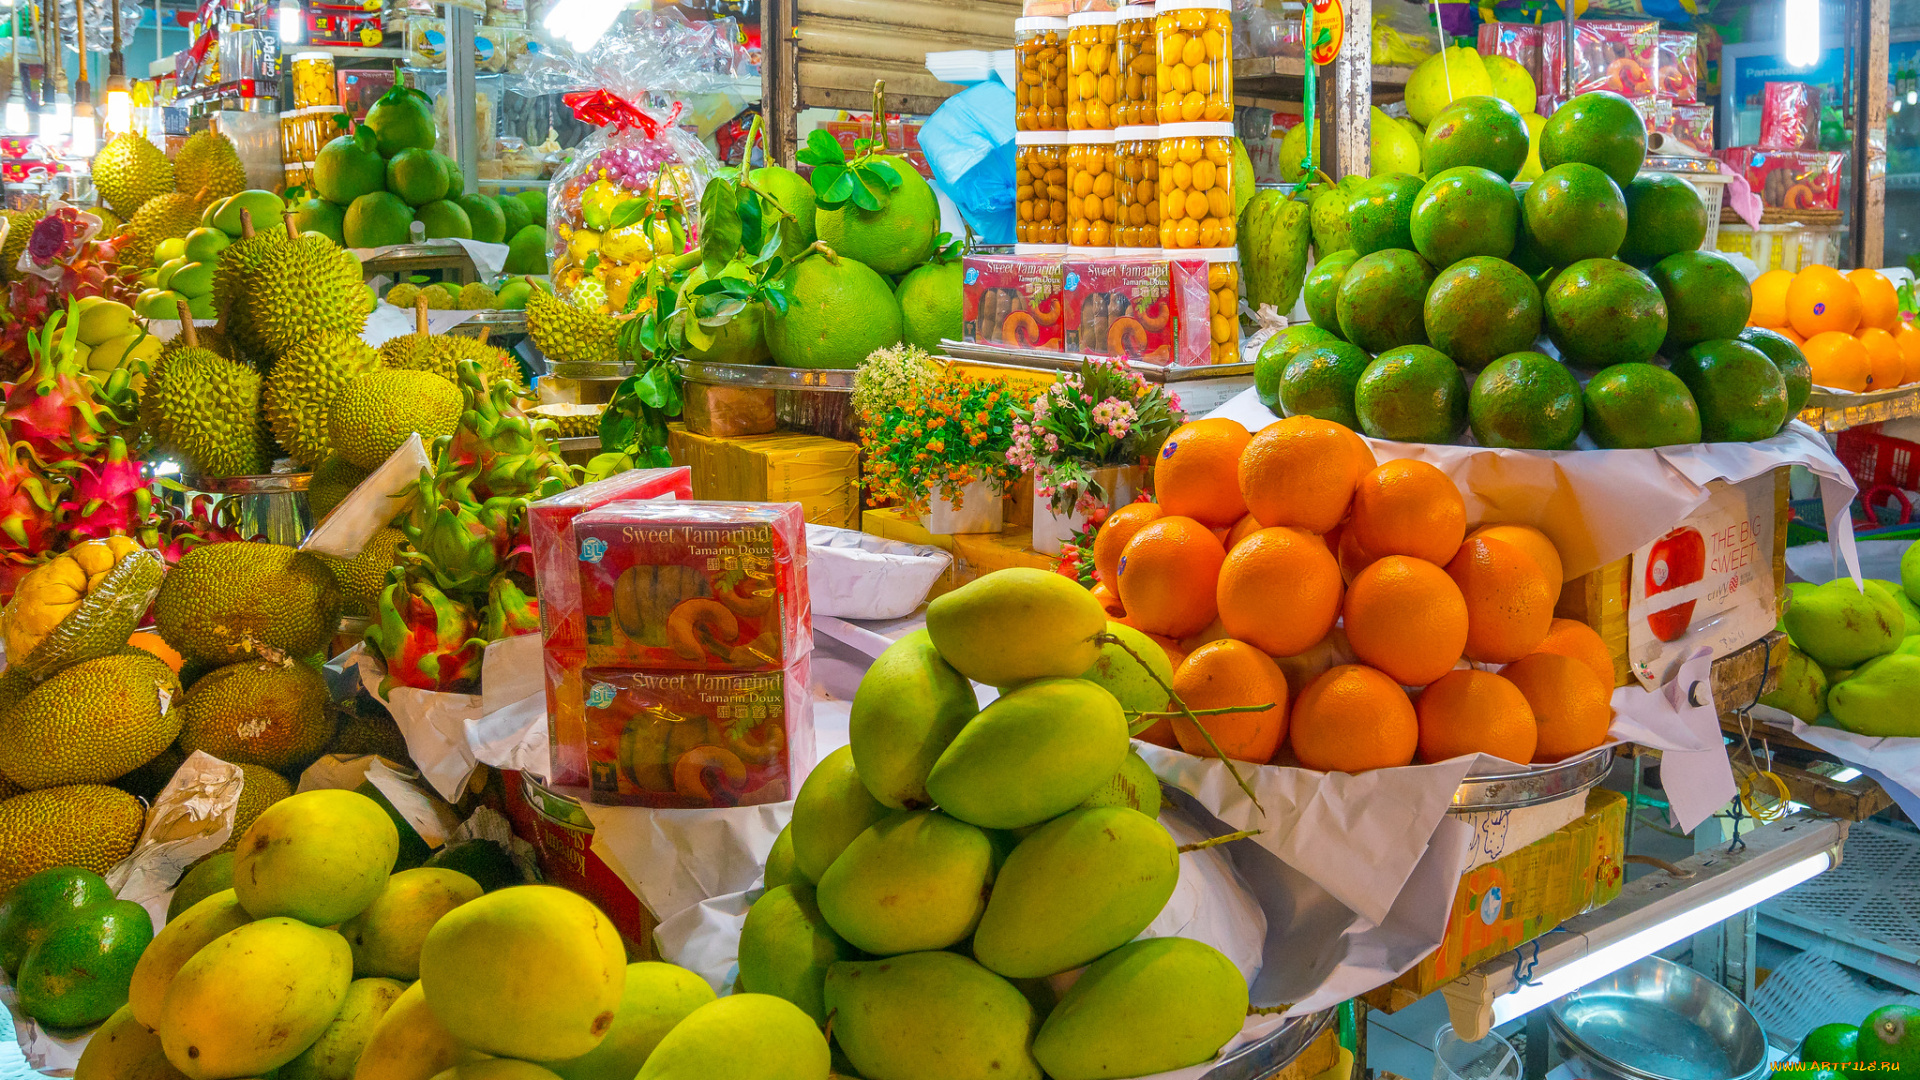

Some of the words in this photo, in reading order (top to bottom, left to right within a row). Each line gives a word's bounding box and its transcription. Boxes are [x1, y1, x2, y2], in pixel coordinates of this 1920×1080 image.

[987, 261, 1014, 274] Sweet
[1016, 261, 1061, 275] Tamarind
[1087, 264, 1117, 277] Sweet
[1119, 264, 1169, 277] Tamarind
[1018, 274, 1042, 283] Tamarin
[1042, 275, 1061, 284] Doux
[1122, 277, 1149, 286] Tamarin
[1149, 278, 1168, 286] Doux
[622, 526, 676, 543] Sweet
[681, 526, 772, 544] Tamarind
[1711, 525, 1737, 555] THE
[1740, 515, 1761, 543] BIG
[687, 545, 735, 555] Tamarin
[738, 545, 770, 555] Doux
[1711, 541, 1757, 574] SWEET
[632, 672, 686, 690] Sweet
[693, 673, 782, 691] Tamarind
[698, 692, 746, 703] Tamarin
[749, 693, 781, 703] Doux
[544, 828, 586, 878] Korean
